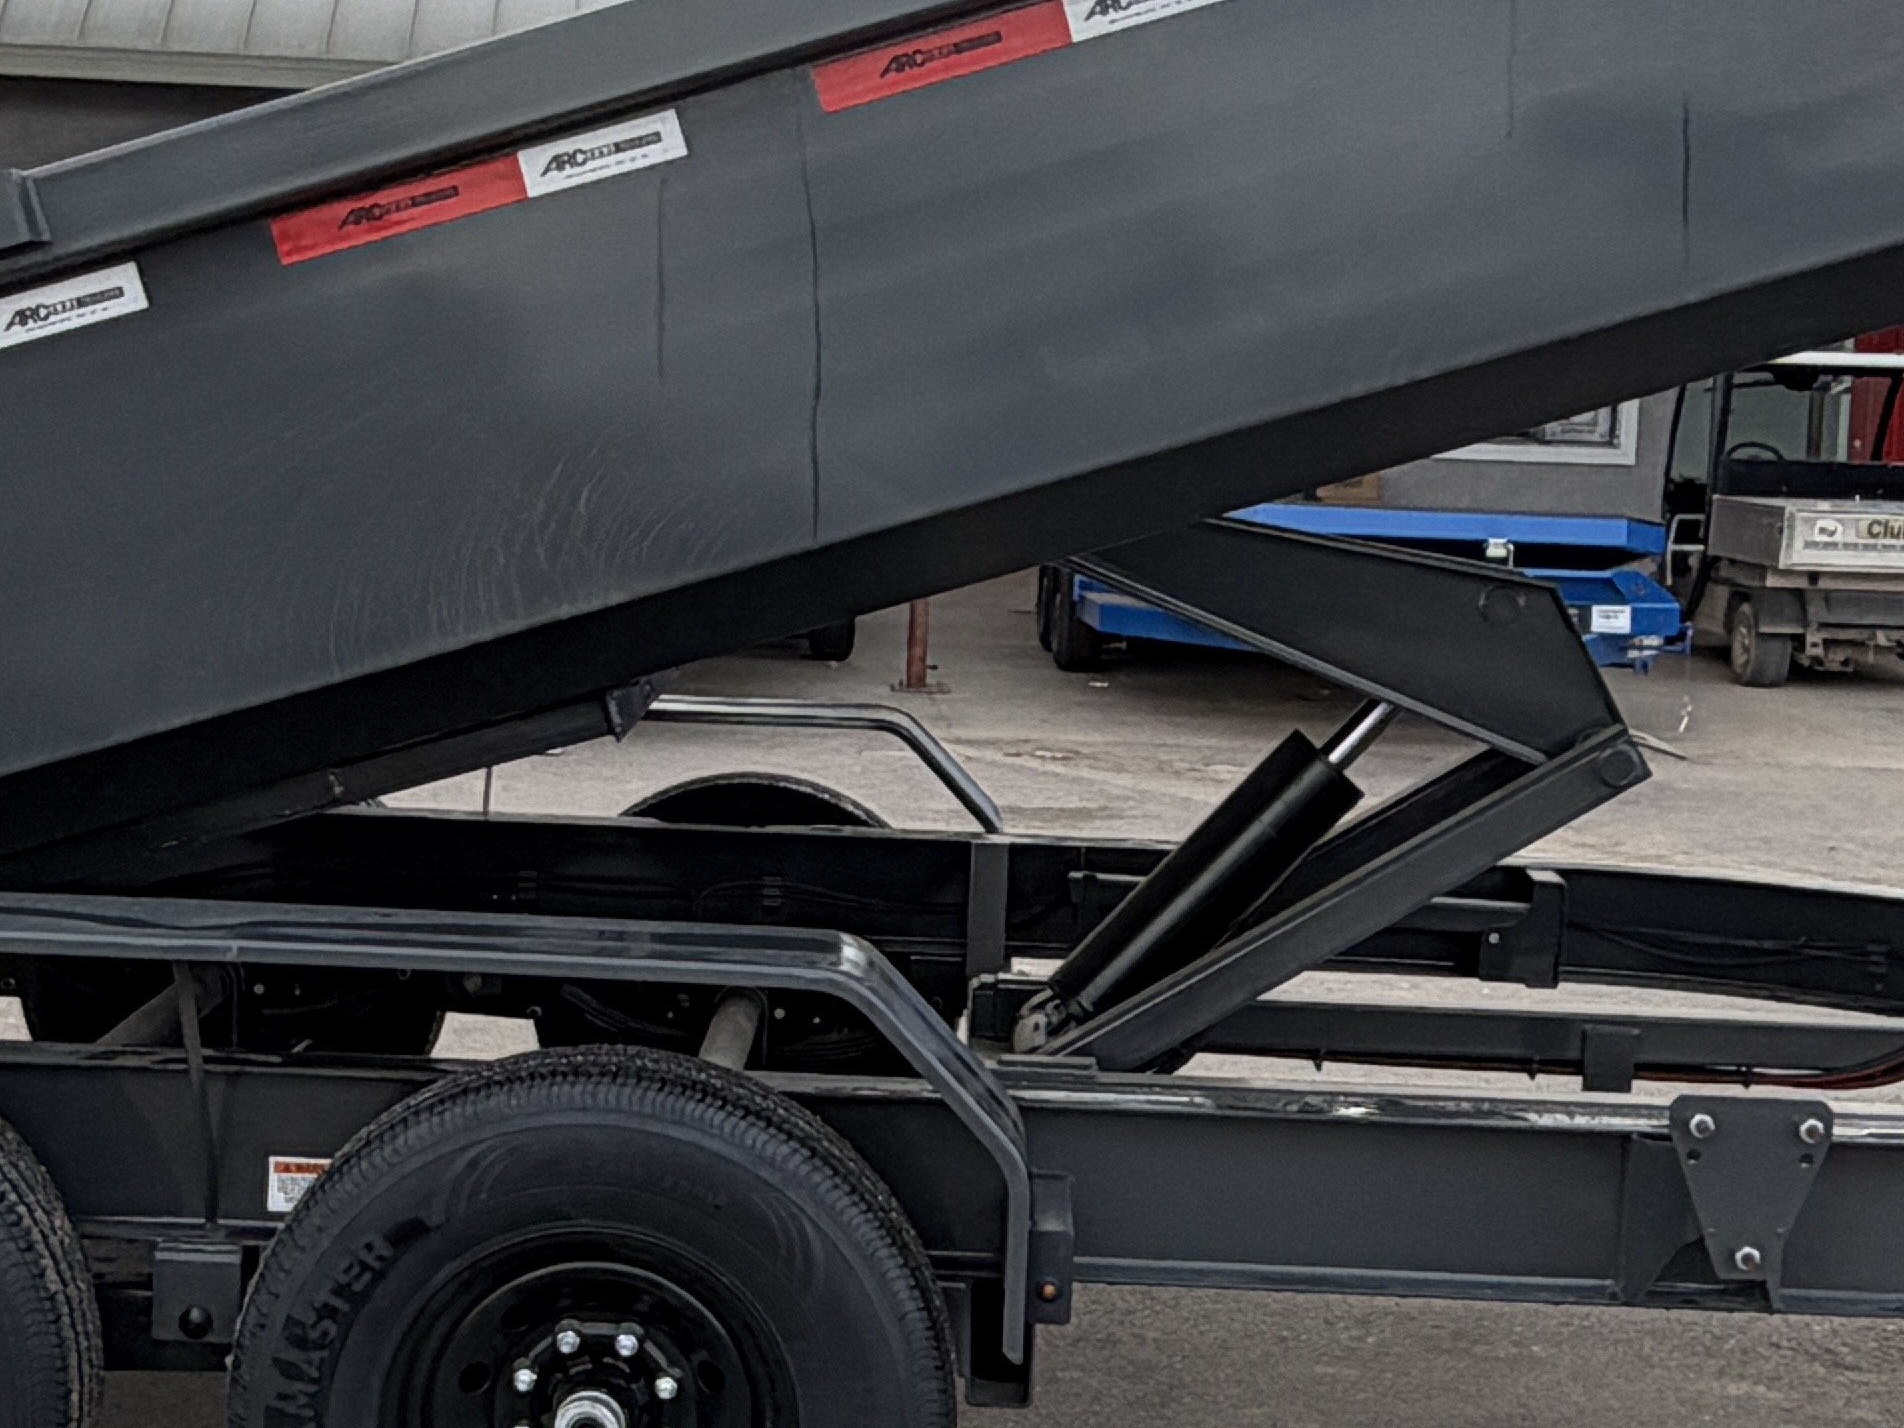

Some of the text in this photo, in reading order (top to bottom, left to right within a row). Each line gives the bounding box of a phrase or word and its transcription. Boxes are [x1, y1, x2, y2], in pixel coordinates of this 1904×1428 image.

[880, 49, 926, 78] ARC
[540, 149, 587, 177] ARC
[338, 203, 386, 230] ARC
[3, 303, 51, 332] ARC
